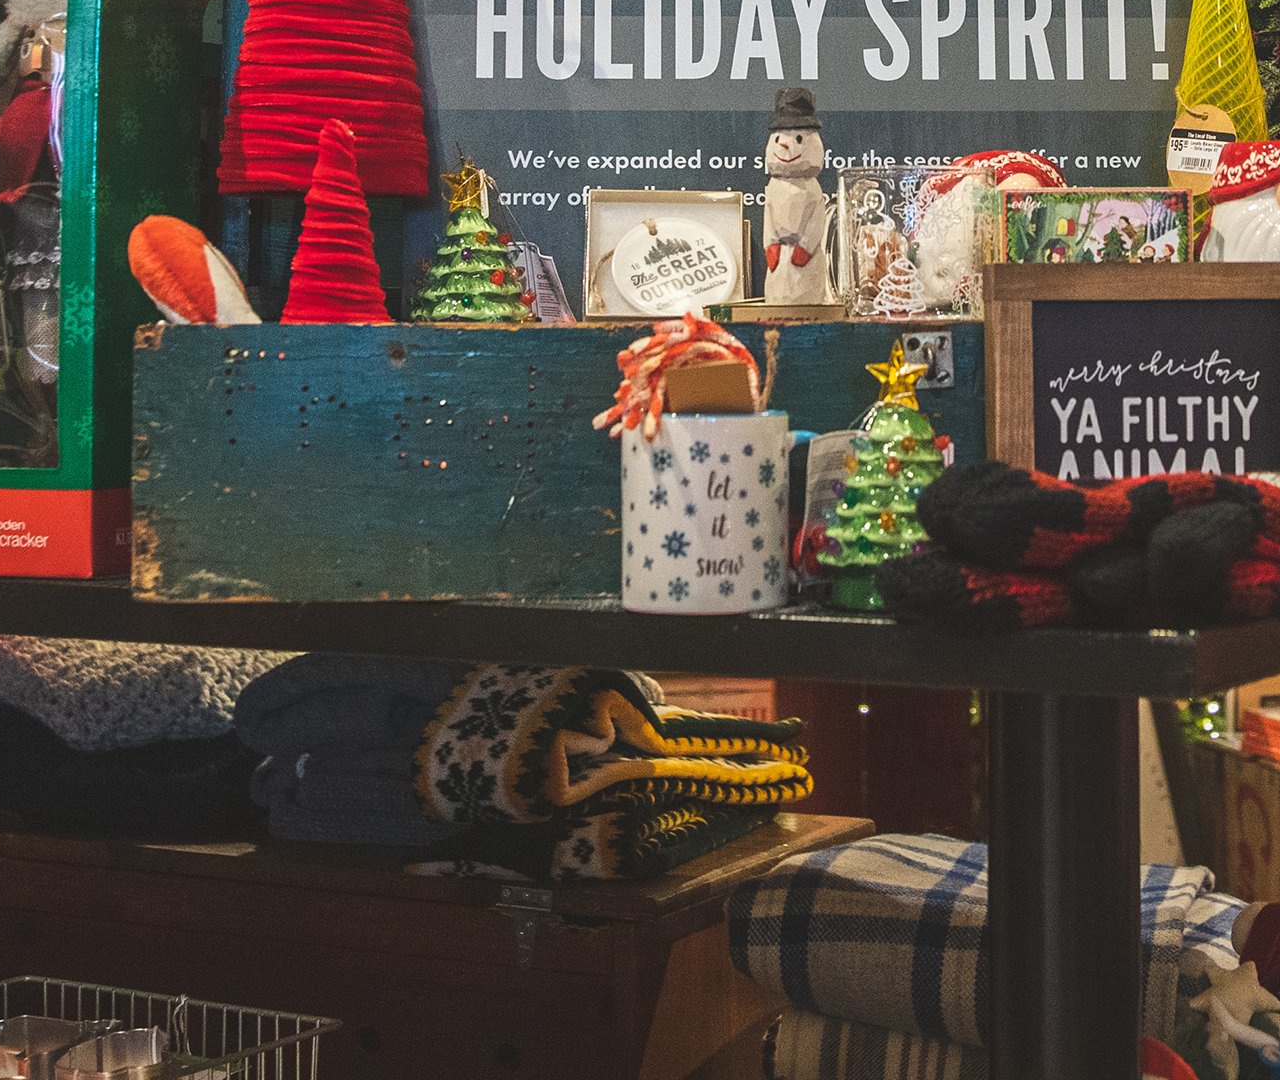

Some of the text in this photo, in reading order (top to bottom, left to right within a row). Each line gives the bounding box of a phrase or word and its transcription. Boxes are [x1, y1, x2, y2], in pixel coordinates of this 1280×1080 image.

[508, 150, 580, 169] We've
[587, 149, 702, 174] expanded
[709, 156, 747, 169] our
[824, 149, 856, 169] for
[861, 149, 896, 168] the
[1075, 155, 1088, 169] a
[1096, 156, 1142, 169] new
[500, 192, 560, 211] array
[570, 186, 591, 205] of
[630, 245, 719, 290] The GREAT
[640, 260, 728, 302] OUTDOORS
[1050, 349, 1260, 392] merry christmas
[1050, 395, 1259, 444] YA FILTHY
[707, 471, 734, 501] let
[711, 513, 730, 540] it
[695, 554, 745, 578] snow
